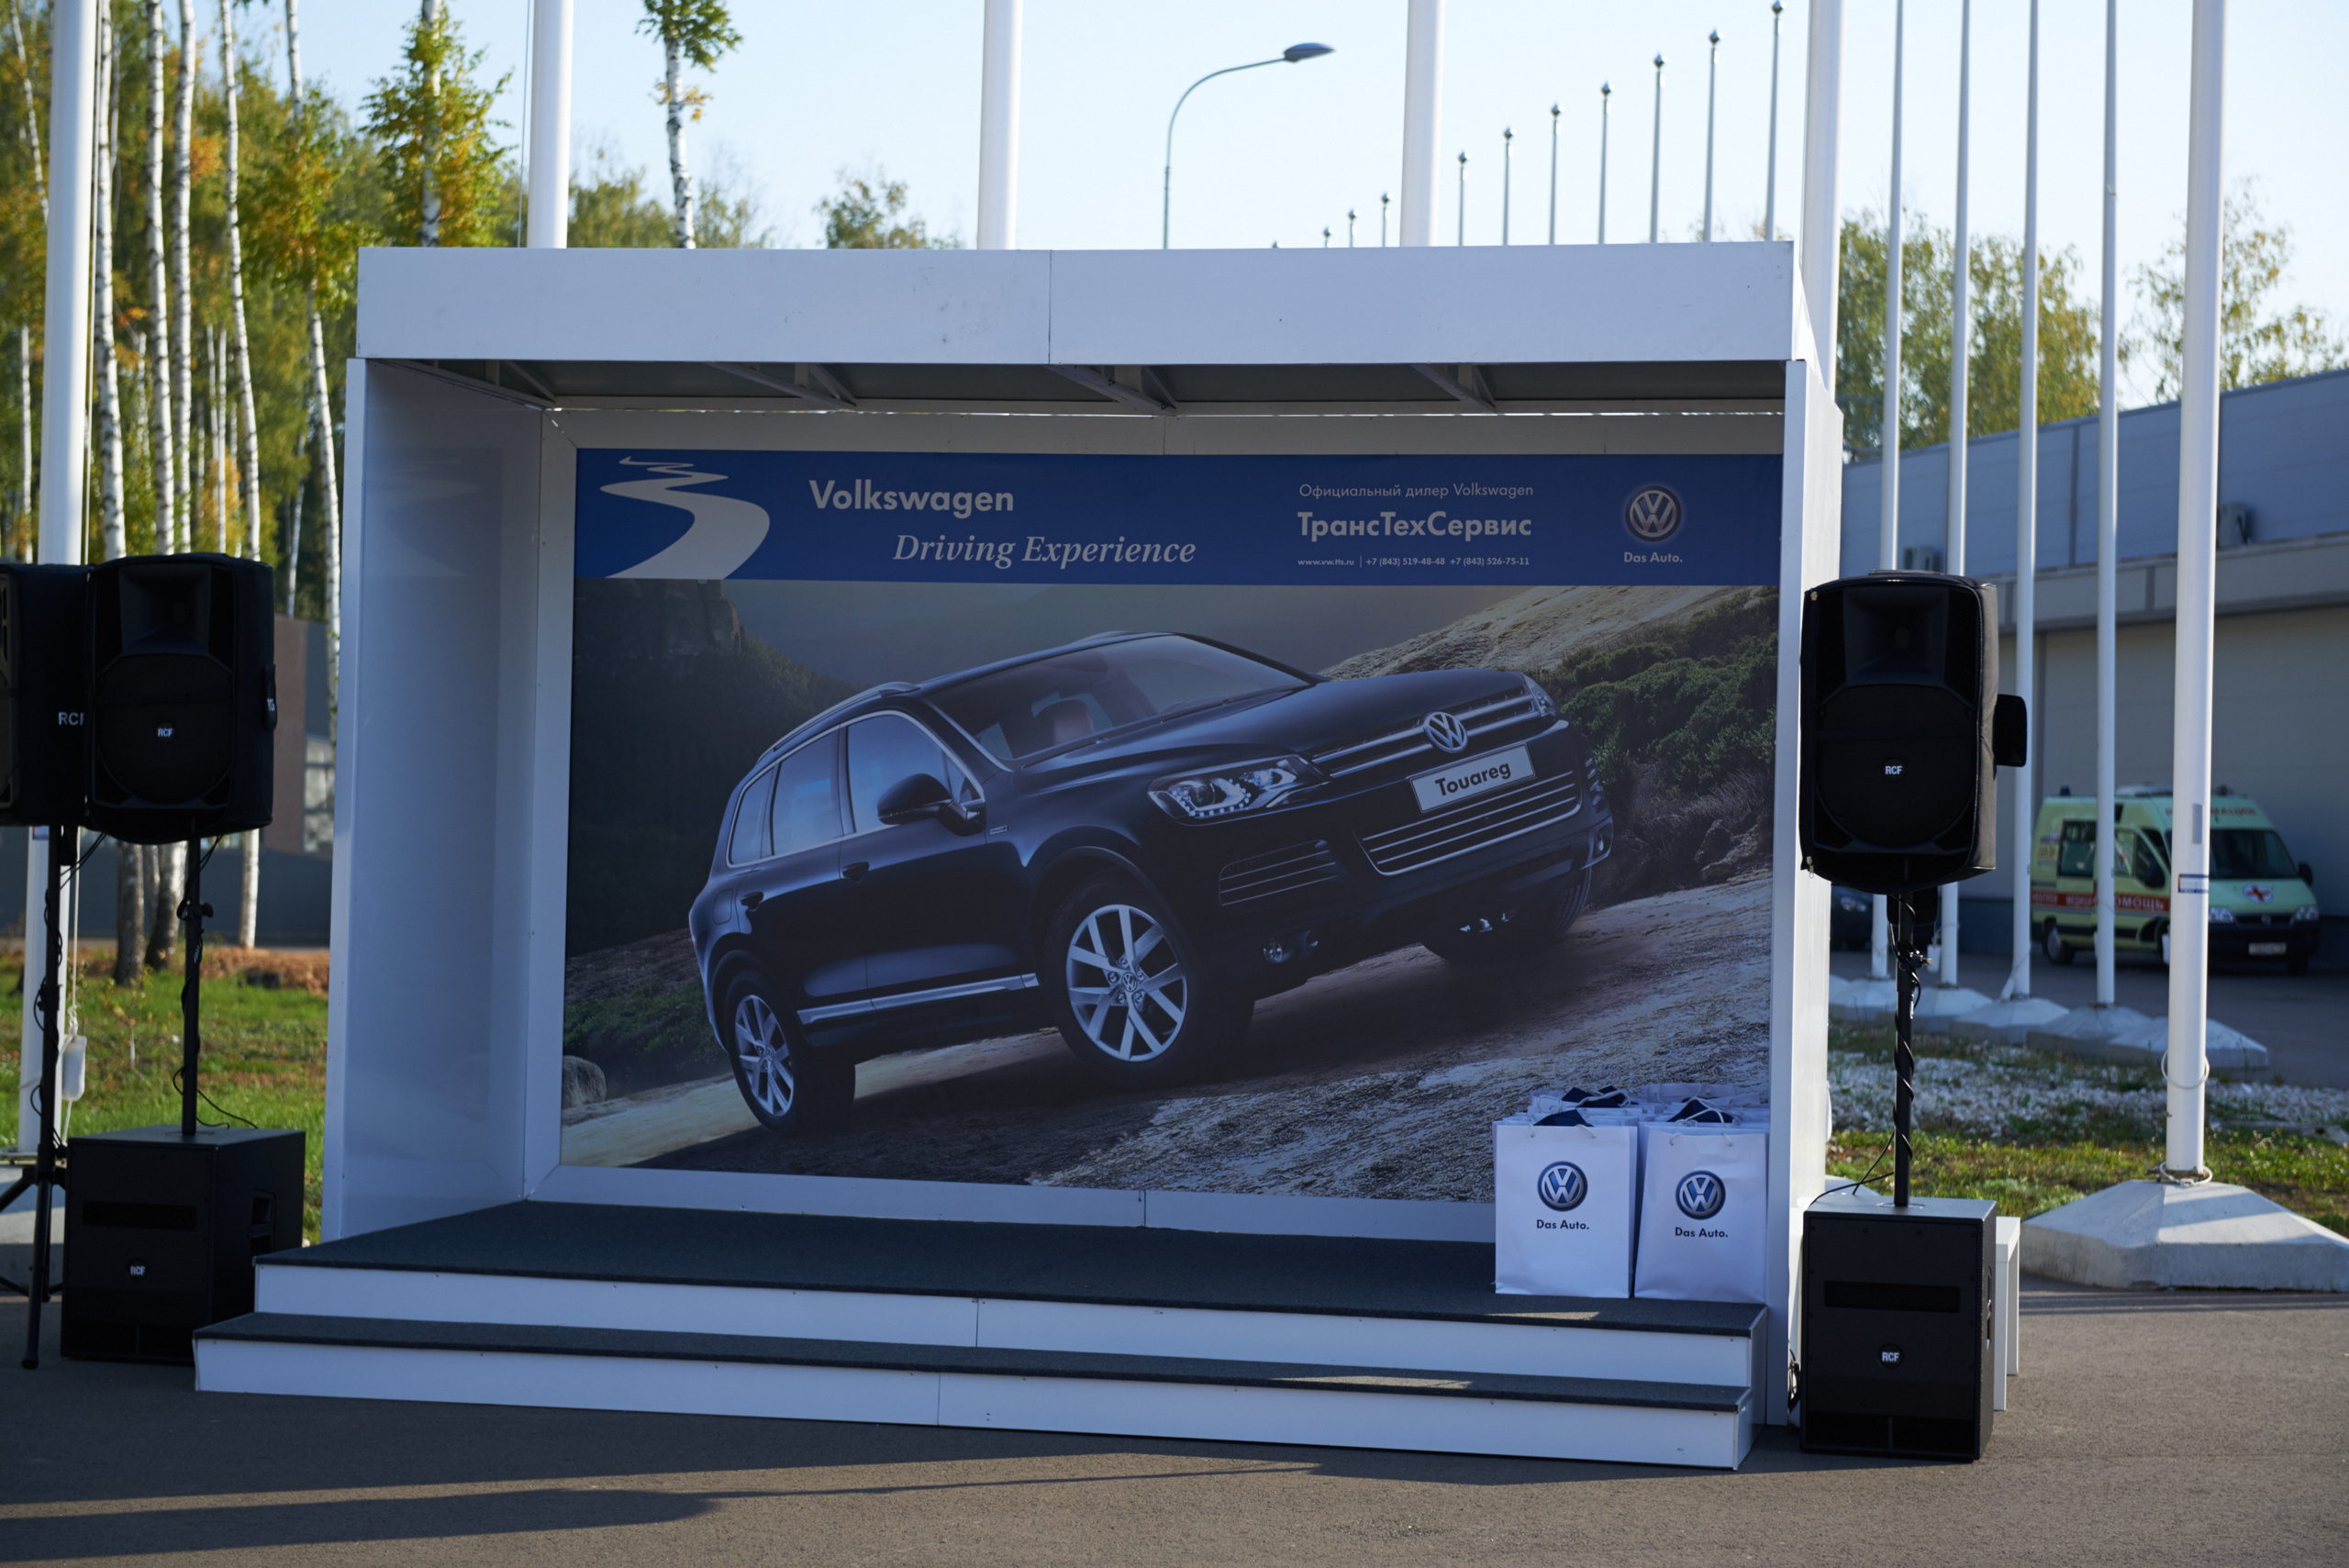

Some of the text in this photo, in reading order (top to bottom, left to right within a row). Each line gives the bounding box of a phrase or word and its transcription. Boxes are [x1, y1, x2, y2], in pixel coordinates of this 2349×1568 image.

[1298, 483, 1533, 500] Официальный дилер Volkswagen
[808, 478, 1014, 519] Volkswagen
[1297, 510, 1532, 543] ТрансТехСервис
[892, 534, 1197, 571] Driving Experience
[1623, 551, 1683, 563] Das Auto.
[1365, 557, 1377, 566] +7
[1379, 556, 1401, 567] (843)
[1402, 557, 1446, 566] 519-48-48
[1450, 557, 1462, 565] +7
[1463, 556, 1485, 567] (843)
[1486, 557, 1530, 565] 526-75-11
[157, 728, 173, 738] RCF
[1885, 765, 1903, 775] RCF
[1434, 762, 1511, 796] Touareg
[1536, 1218, 1590, 1230] Das Auto.
[1675, 1227, 1729, 1238] Das Auto.
[129, 1265, 146, 1276] RCF
[1881, 1351, 1900, 1362] RCF
